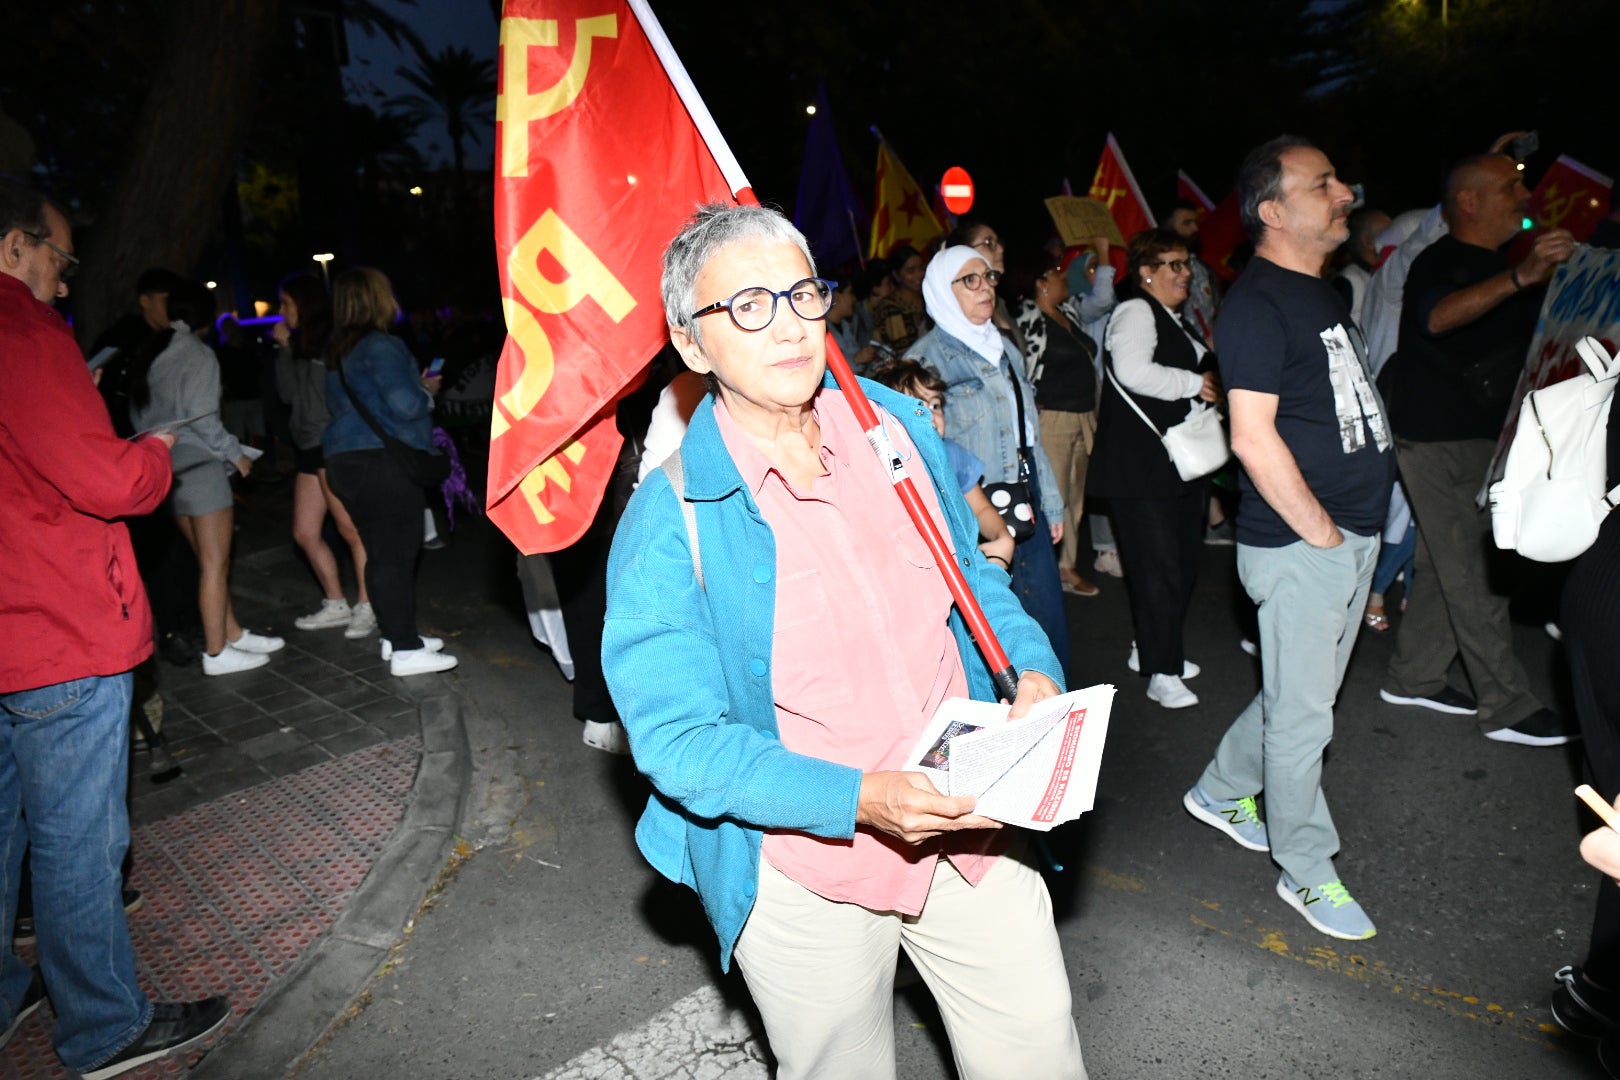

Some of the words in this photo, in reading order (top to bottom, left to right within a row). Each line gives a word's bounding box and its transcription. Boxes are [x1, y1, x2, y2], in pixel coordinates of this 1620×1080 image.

[1077, 712, 1084, 721] EL
[1064, 724, 1081, 768] SIONISMO
[1060, 769, 1069, 781] ES
[1043, 783, 1066, 820] NAZISMO
